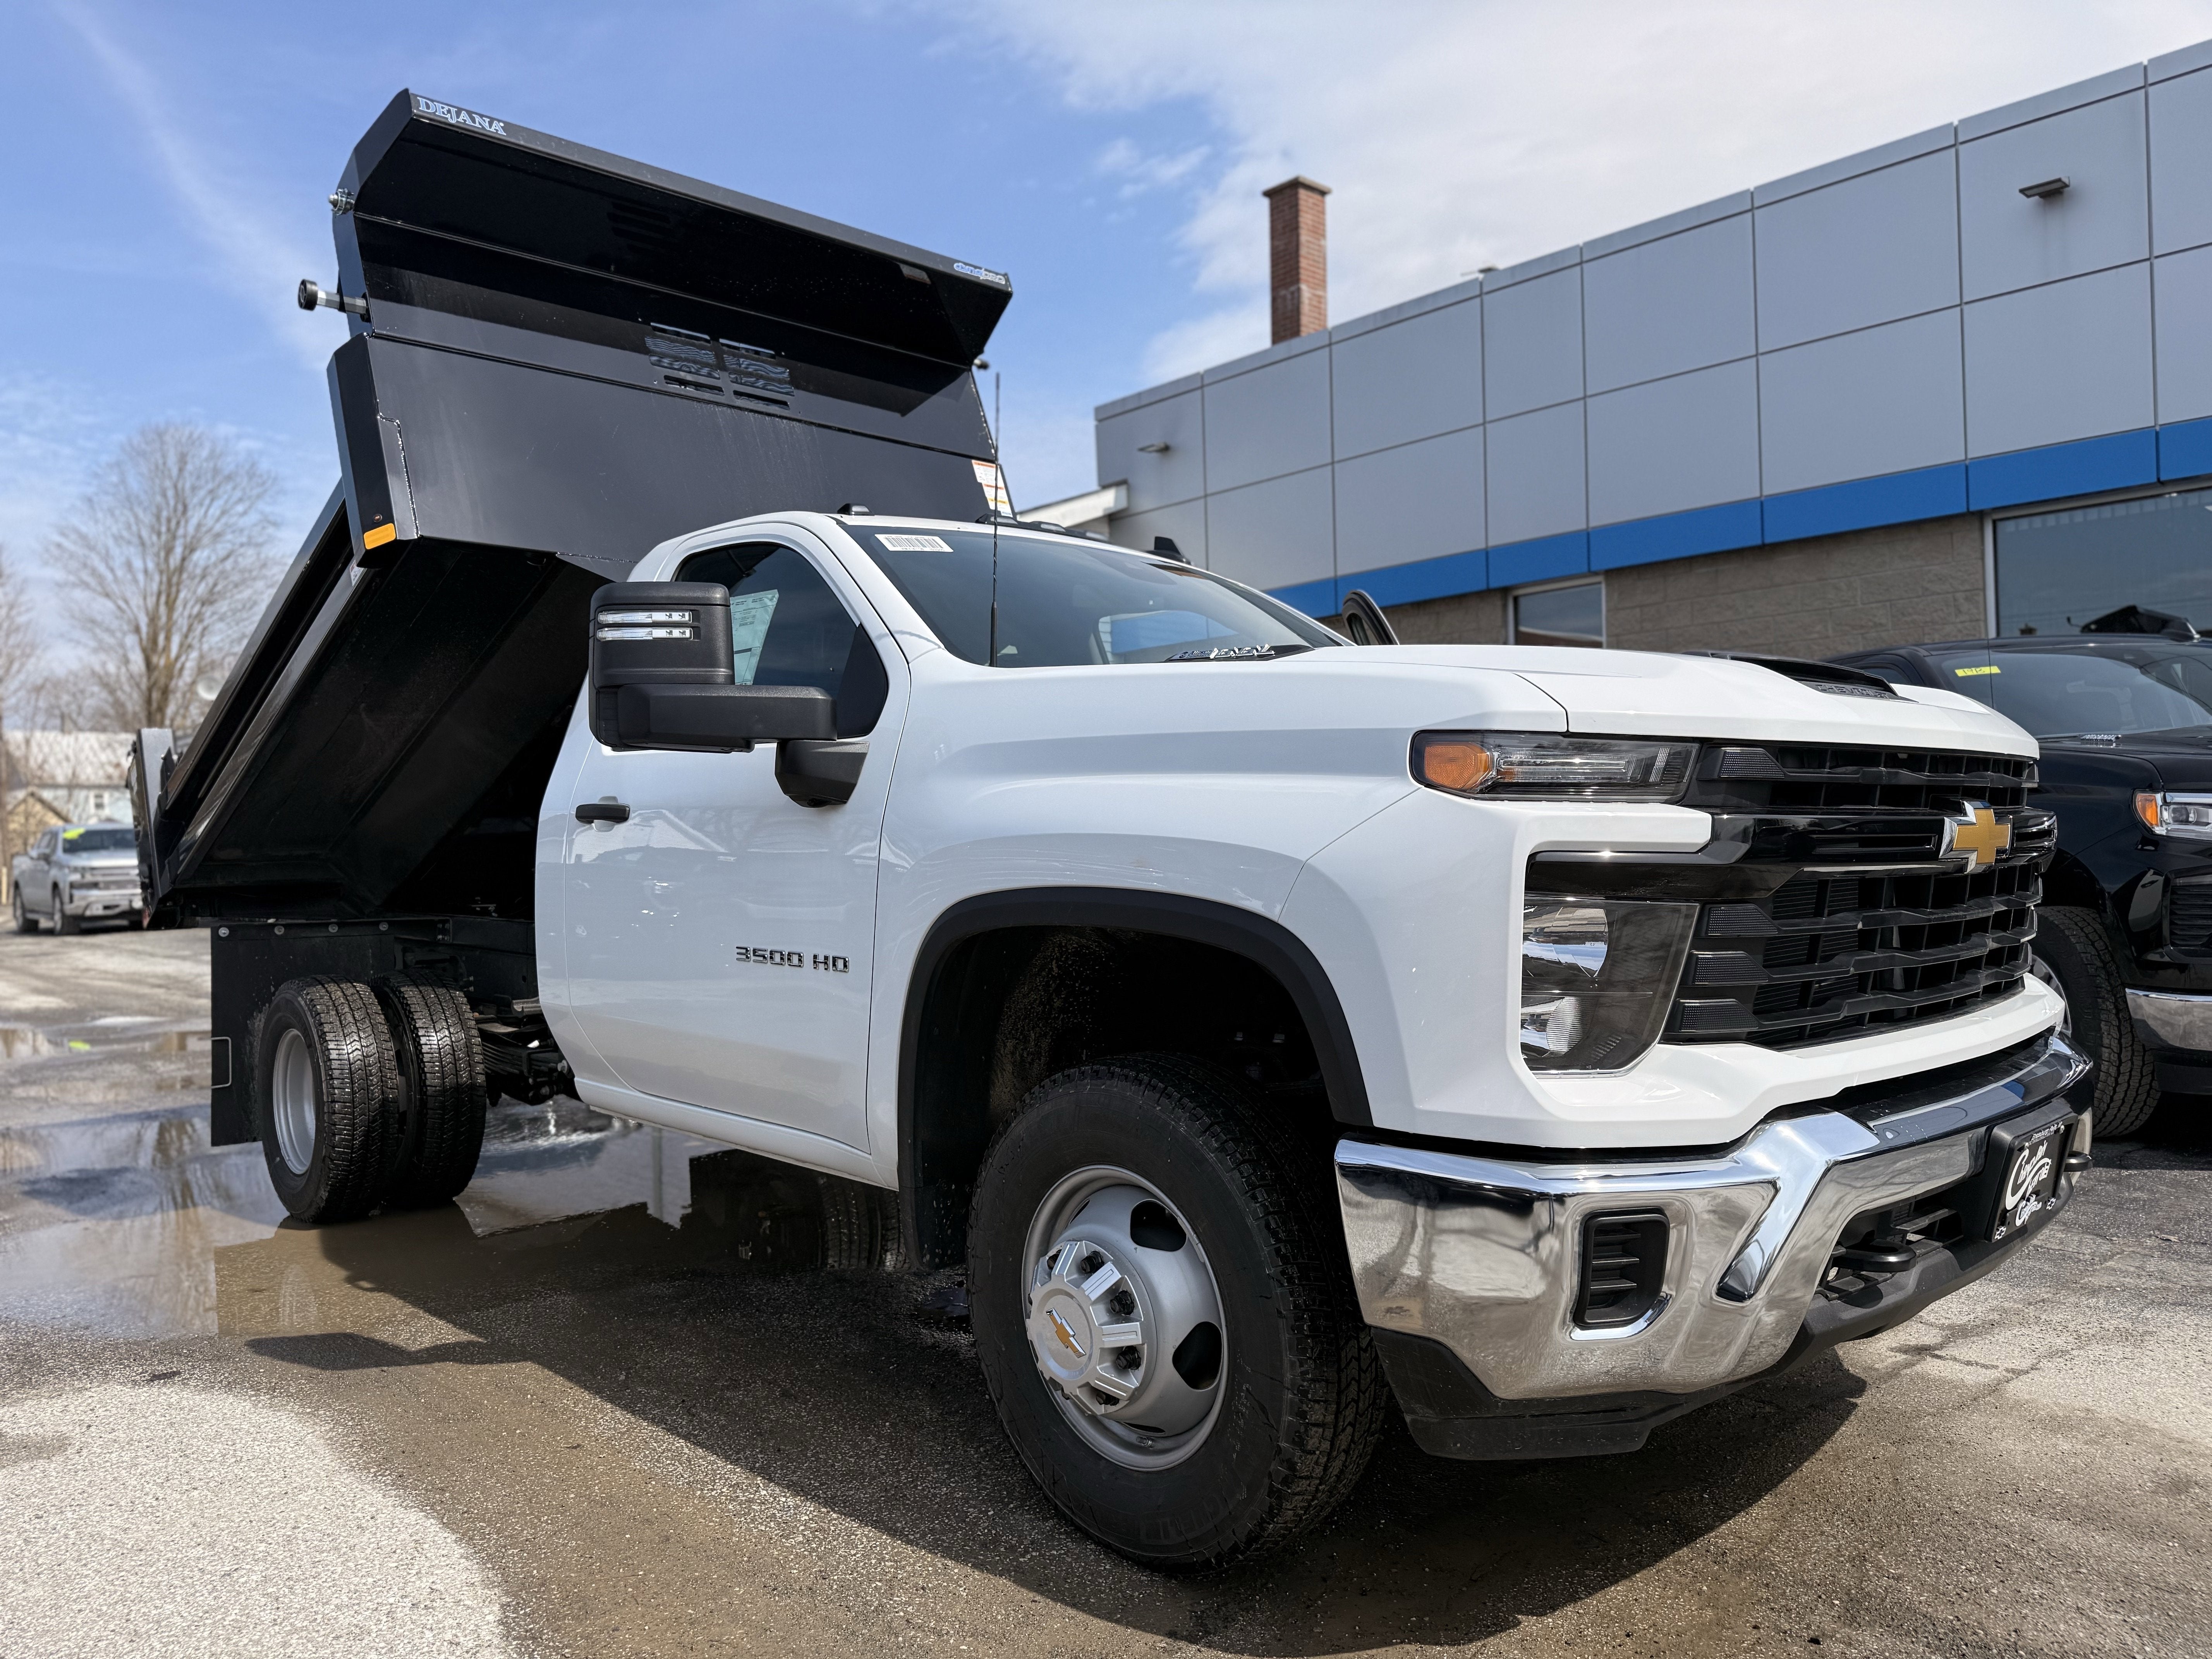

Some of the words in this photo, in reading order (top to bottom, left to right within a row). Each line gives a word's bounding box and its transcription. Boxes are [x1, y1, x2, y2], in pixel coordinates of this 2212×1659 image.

[417, 96, 506, 136] DEJANA
[736, 946, 804, 968] 3500
[813, 953, 849, 973] HD
